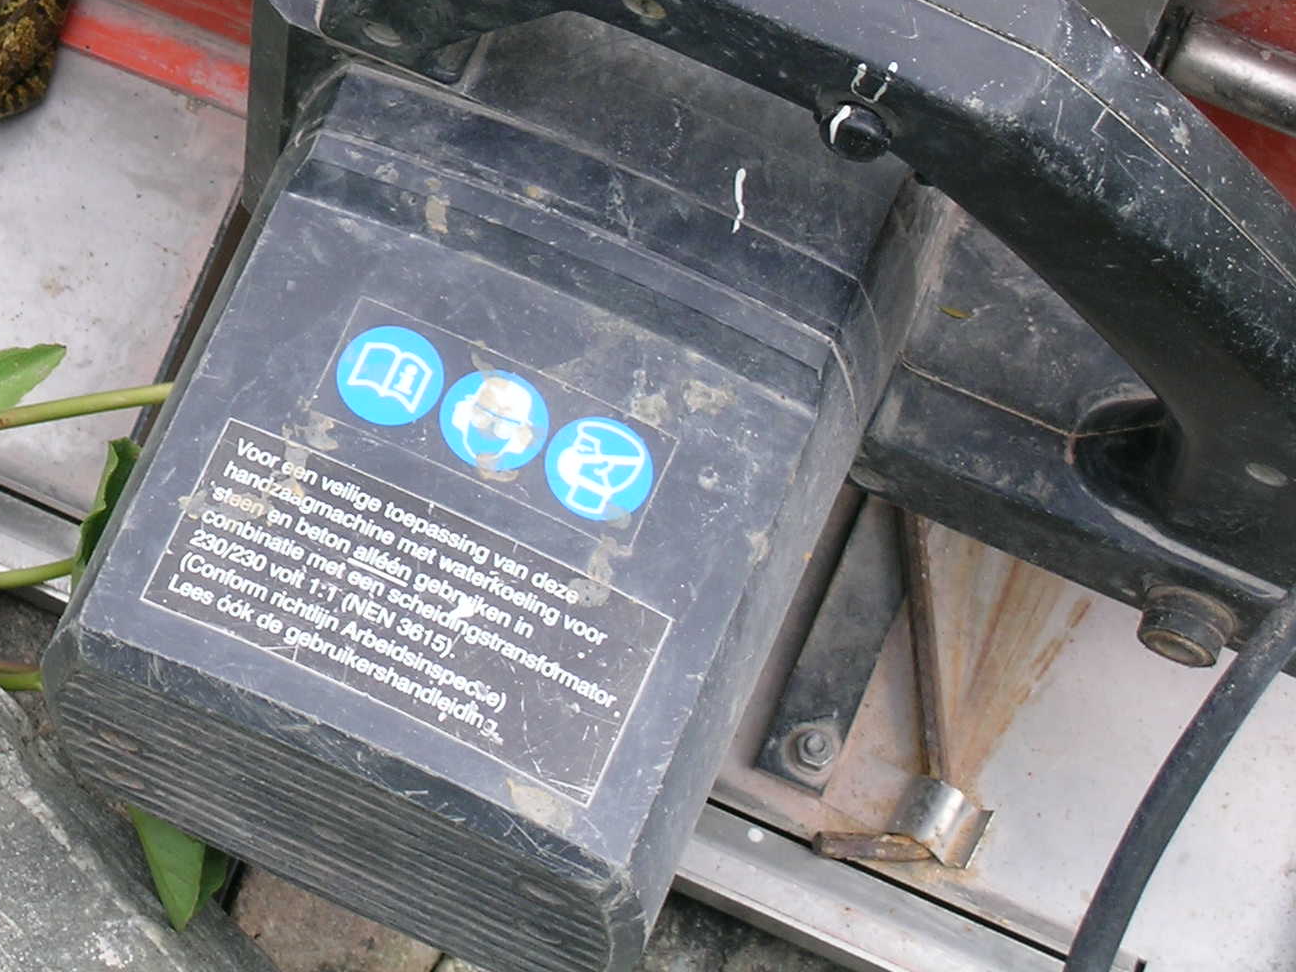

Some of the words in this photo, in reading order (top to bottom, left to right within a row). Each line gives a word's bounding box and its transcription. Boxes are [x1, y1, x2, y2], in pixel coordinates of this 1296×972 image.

[201, 509, 305, 560] combinatie
[306, 553, 346, 579] met
[347, 571, 385, 598] een
[212, 486, 264, 516] steen
[267, 508, 293, 528] en
[295, 517, 351, 554] beton
[352, 545, 412, 581] alléén
[513, 616, 534, 638] in
[223, 460, 396, 545] handzaagmachine
[396, 536, 438, 564] met
[438, 555, 561, 626] waterkoeling
[563, 615, 608, 645] voor
[237, 438, 280, 469] Voor
[281, 462, 318, 485] een
[321, 476, 382, 513] veilige
[384, 502, 490, 564] toepassing
[493, 553, 529, 580] van
[531, 572, 579, 604] deze
[167, 574, 214, 605] Lees
[216, 594, 254, 622] óók
[256, 612, 283, 634] de
[180, 552, 268, 602] (Conform
[269, 590, 339, 631] richtlijn
[189, 529, 267, 572] 230/230
[269, 562, 305, 588] volt
[309, 578, 338, 602] 1:1
[341, 593, 397, 628] (NEN
[396, 618, 455, 659] 3615).
